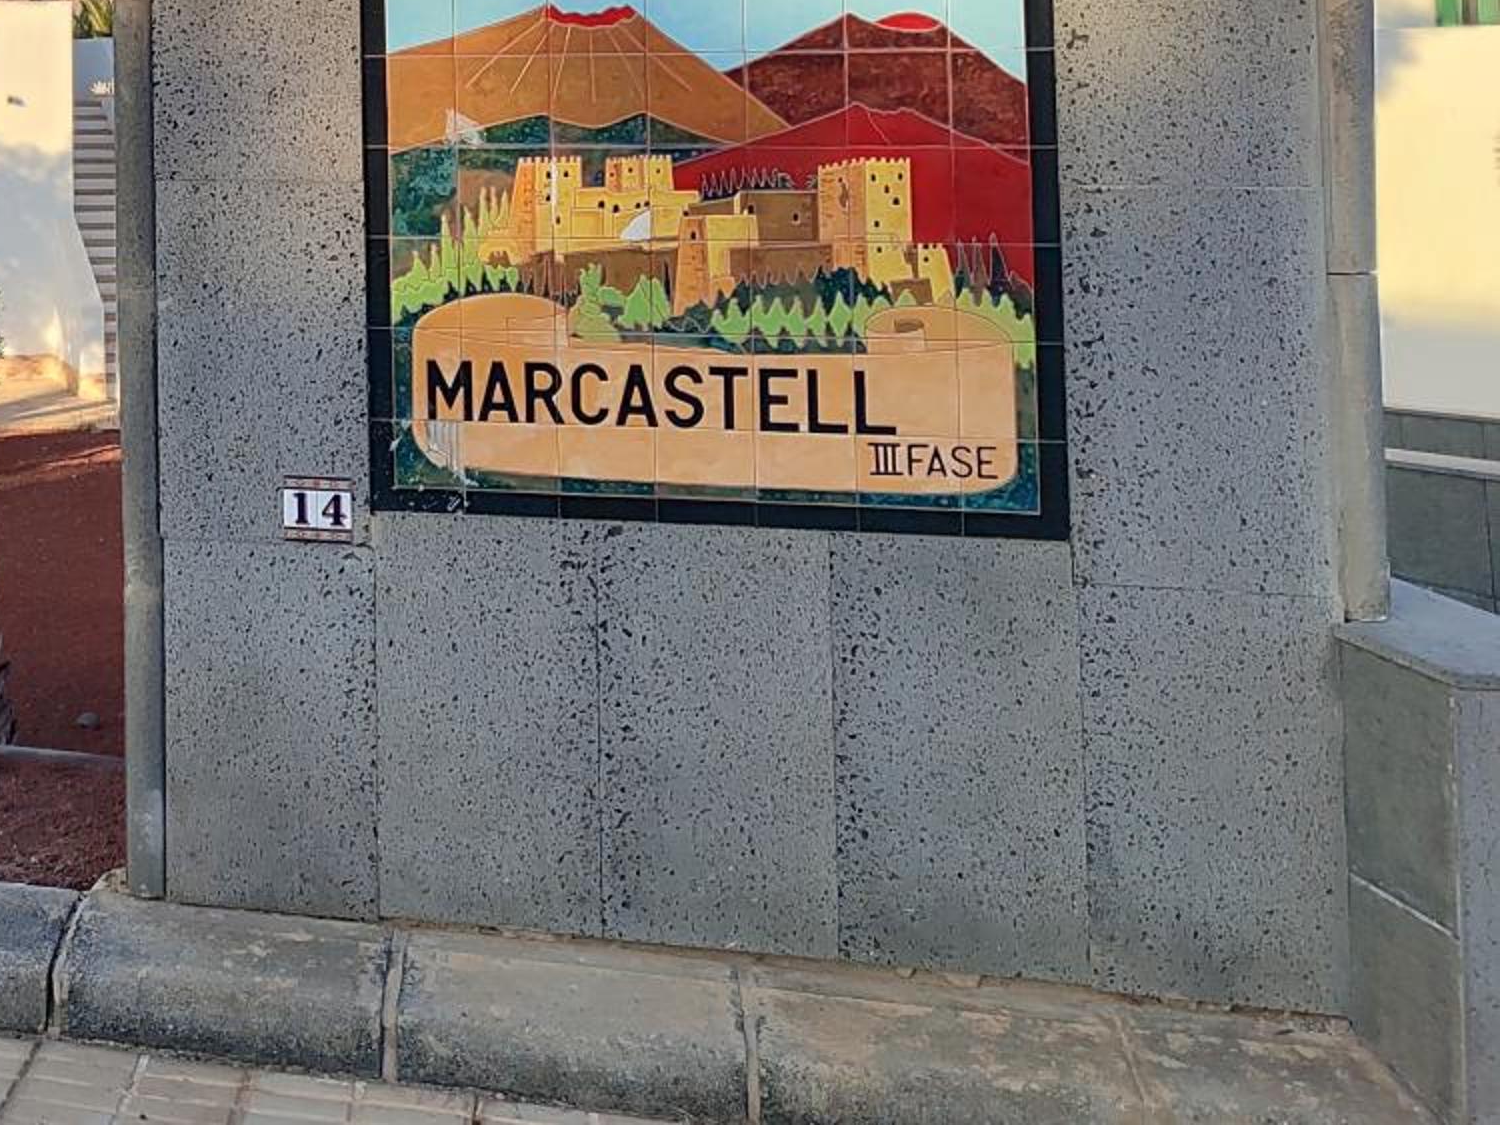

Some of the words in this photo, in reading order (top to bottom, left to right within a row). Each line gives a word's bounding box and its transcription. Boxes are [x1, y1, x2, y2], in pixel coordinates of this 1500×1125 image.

[426, 360, 897, 436] MARCASTELL
[906, 443, 999, 480] FASE
[292, 492, 348, 527] 14
